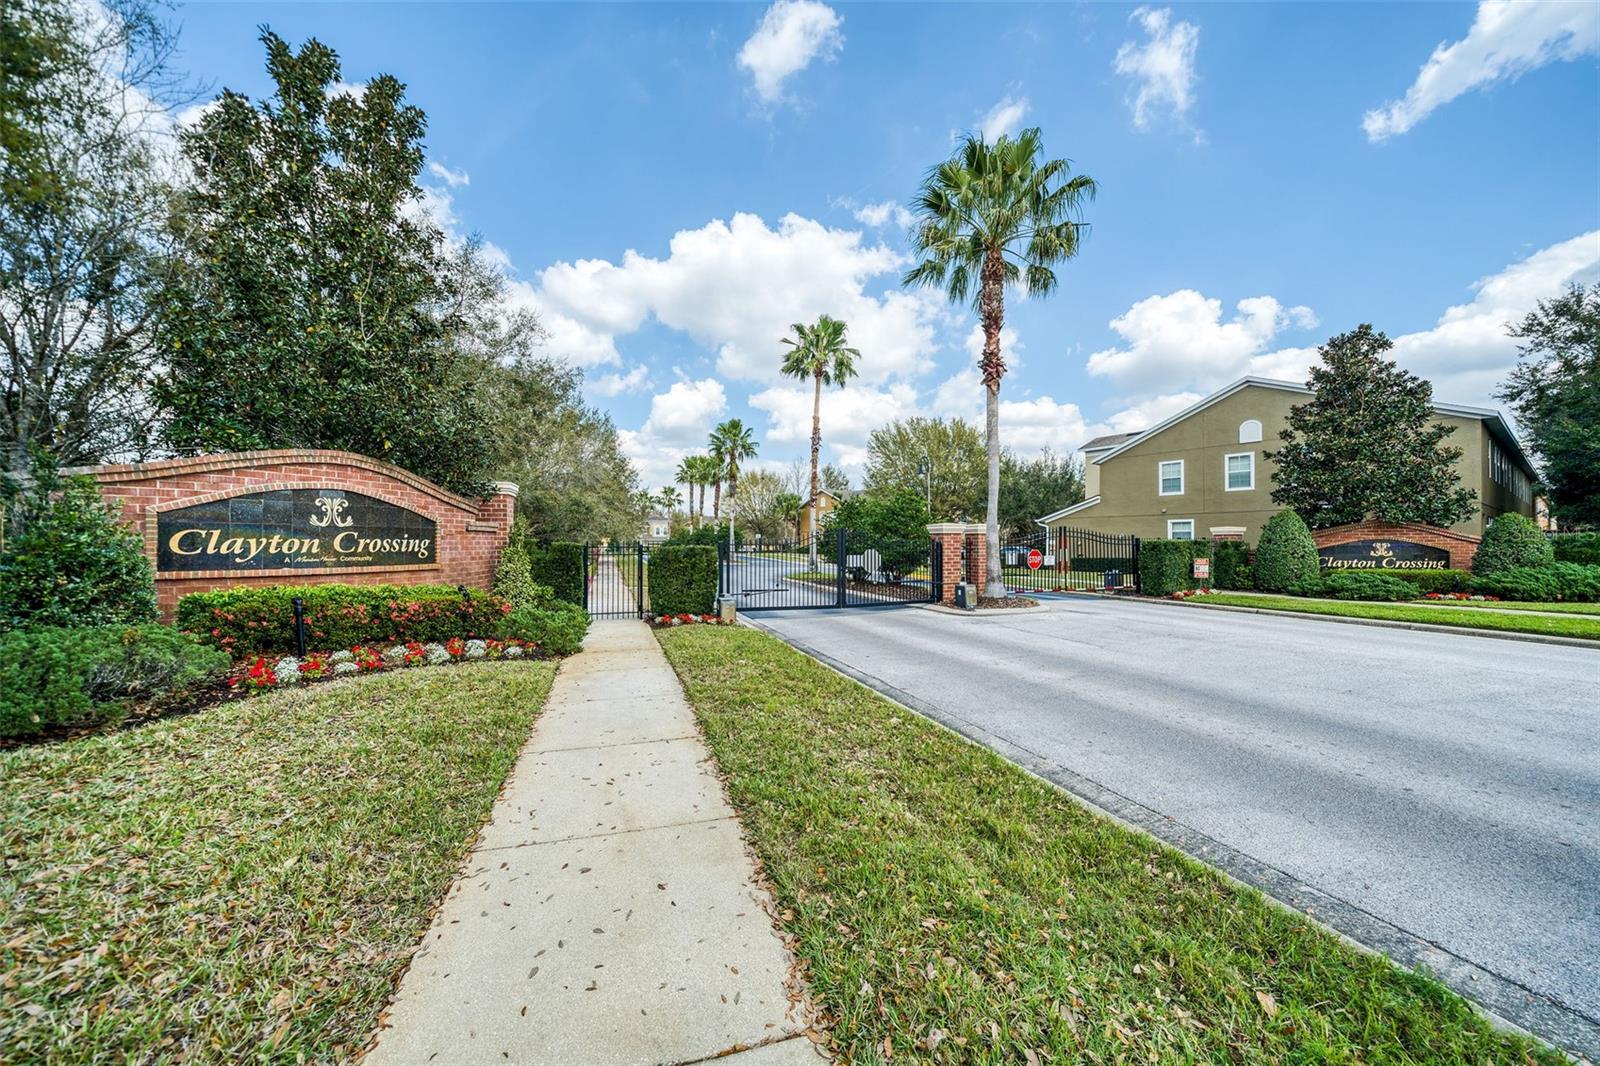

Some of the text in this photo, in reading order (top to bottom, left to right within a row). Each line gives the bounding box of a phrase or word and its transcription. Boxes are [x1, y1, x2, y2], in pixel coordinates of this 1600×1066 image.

[168, 529, 430, 563] Clayton Crossing
[1029, 555, 1042, 564] STOP
[1318, 556, 1446, 570] Clayton Crossing
